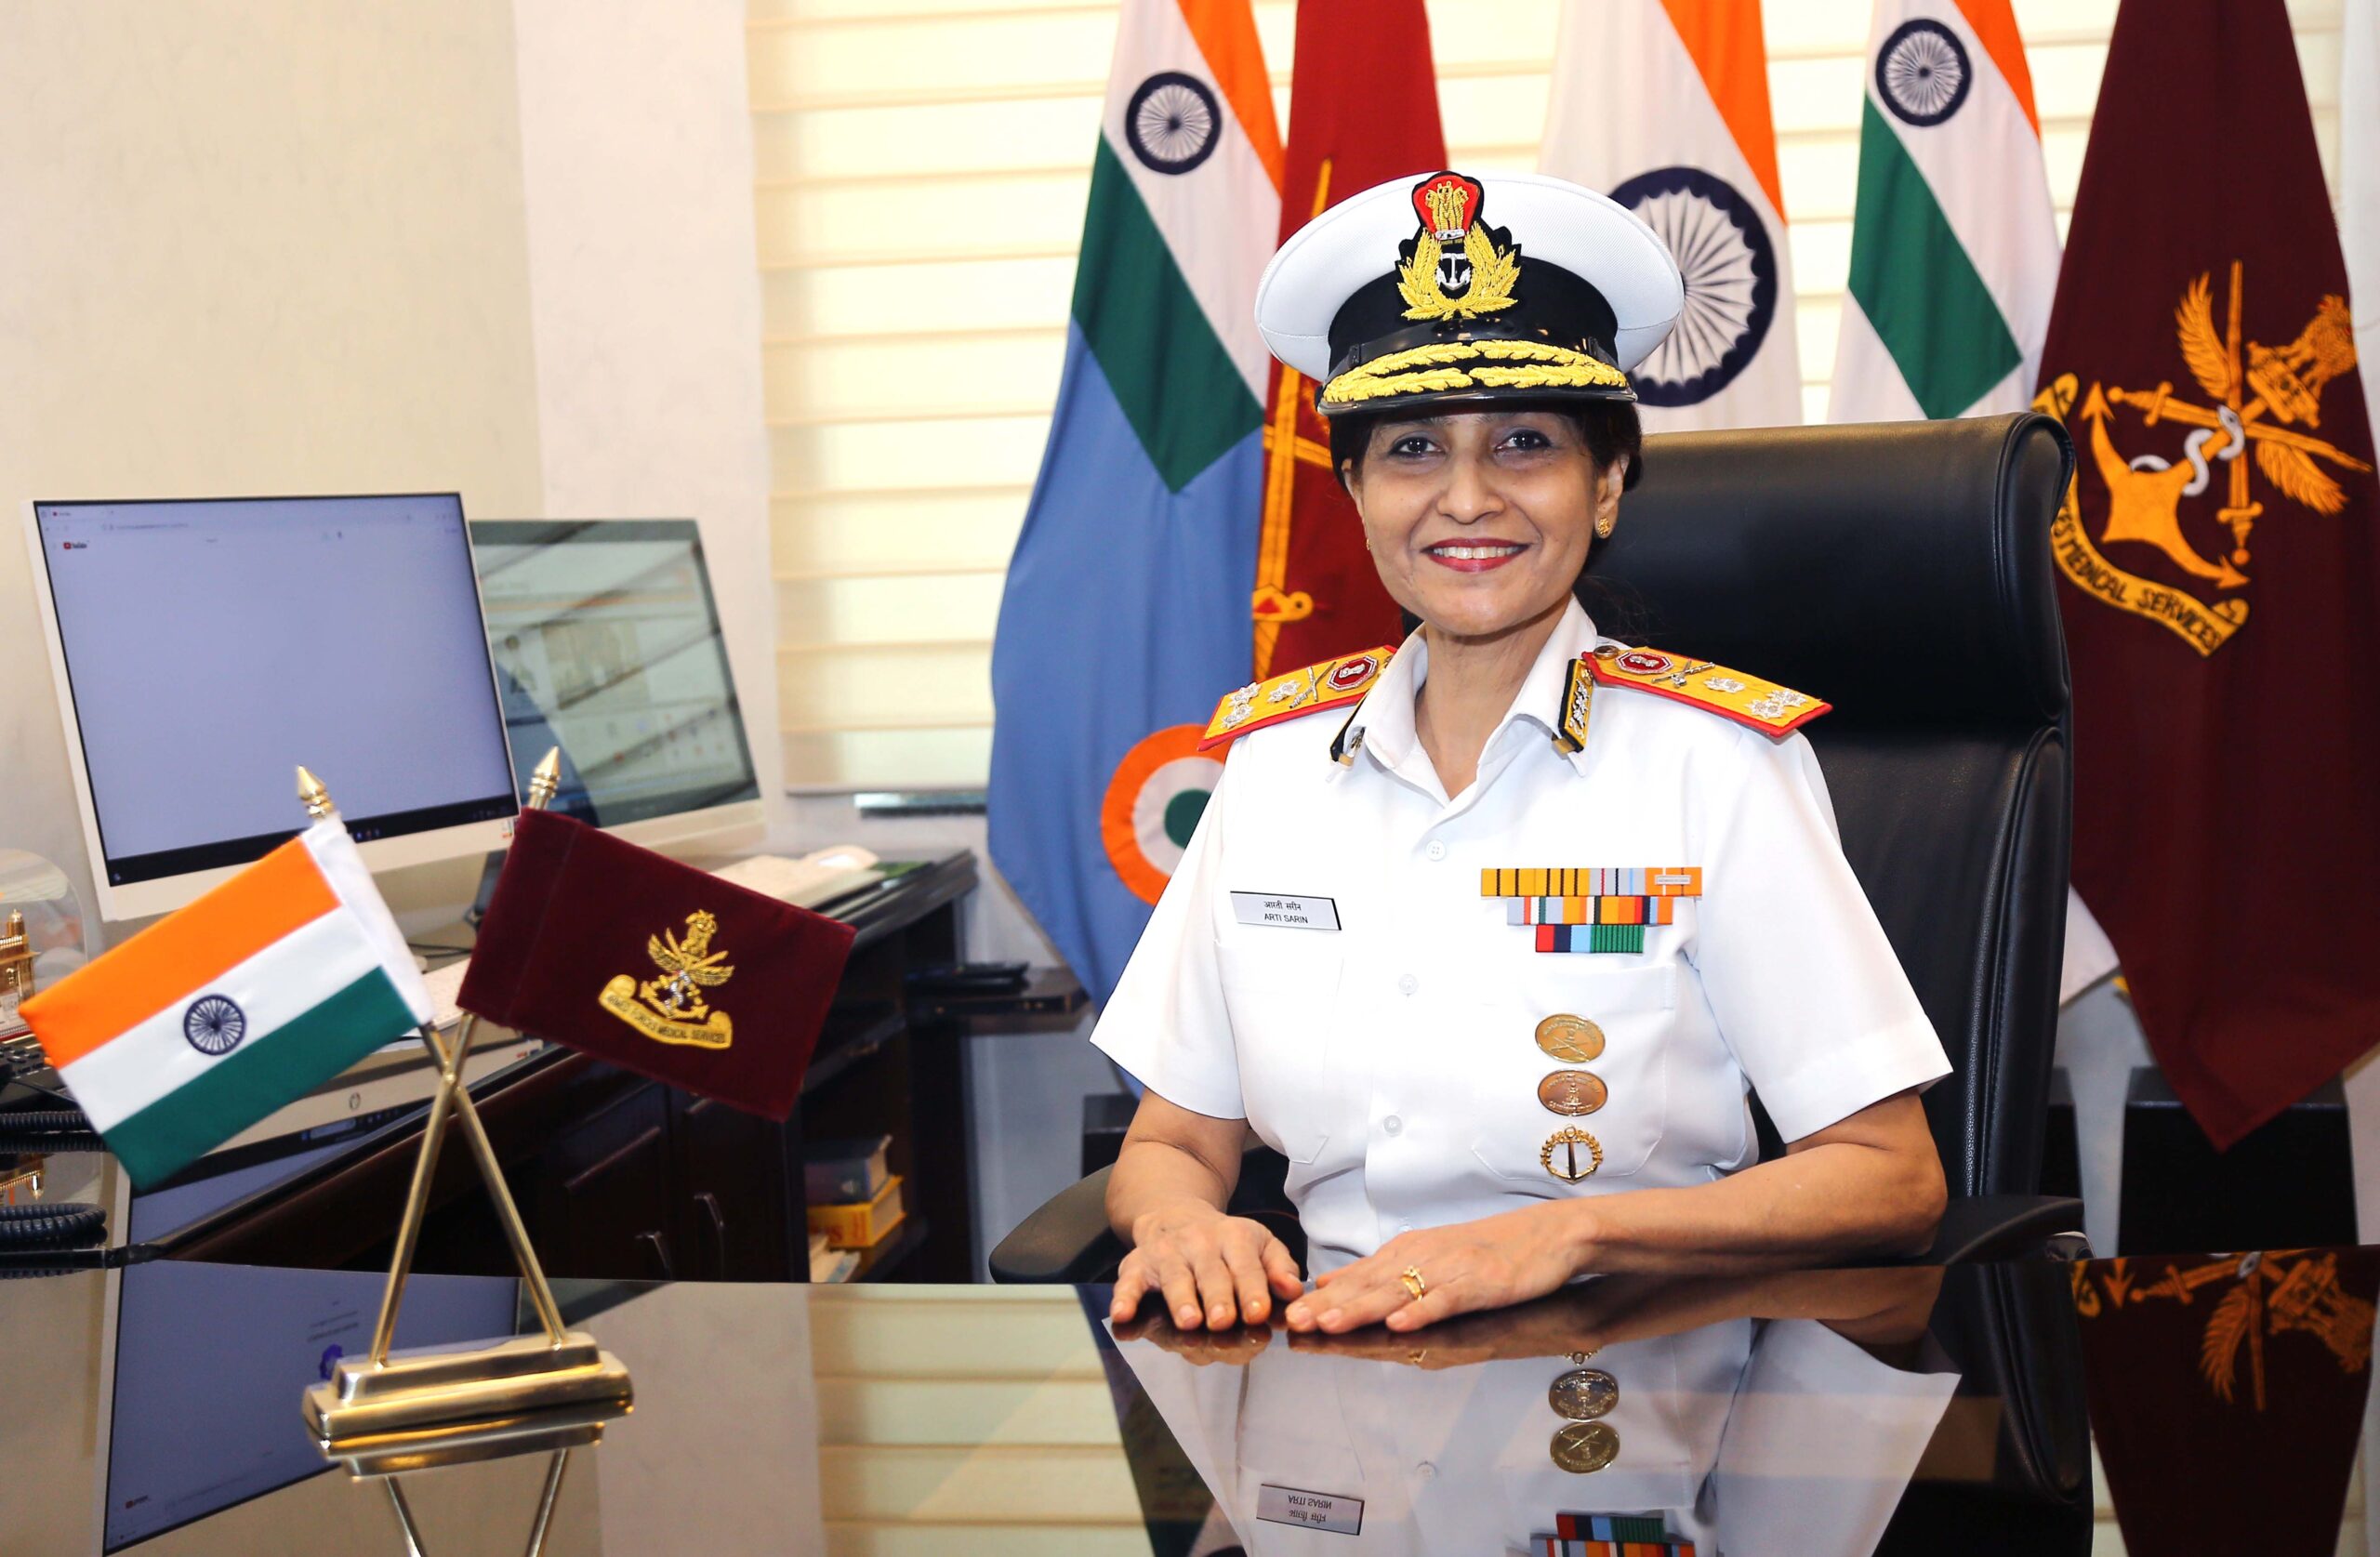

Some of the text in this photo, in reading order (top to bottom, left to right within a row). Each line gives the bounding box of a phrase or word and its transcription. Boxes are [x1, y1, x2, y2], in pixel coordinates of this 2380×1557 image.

[2057, 536, 2223, 650] MEDICAL SERVICES
[1264, 913, 1308, 924] ARTI SARIN
